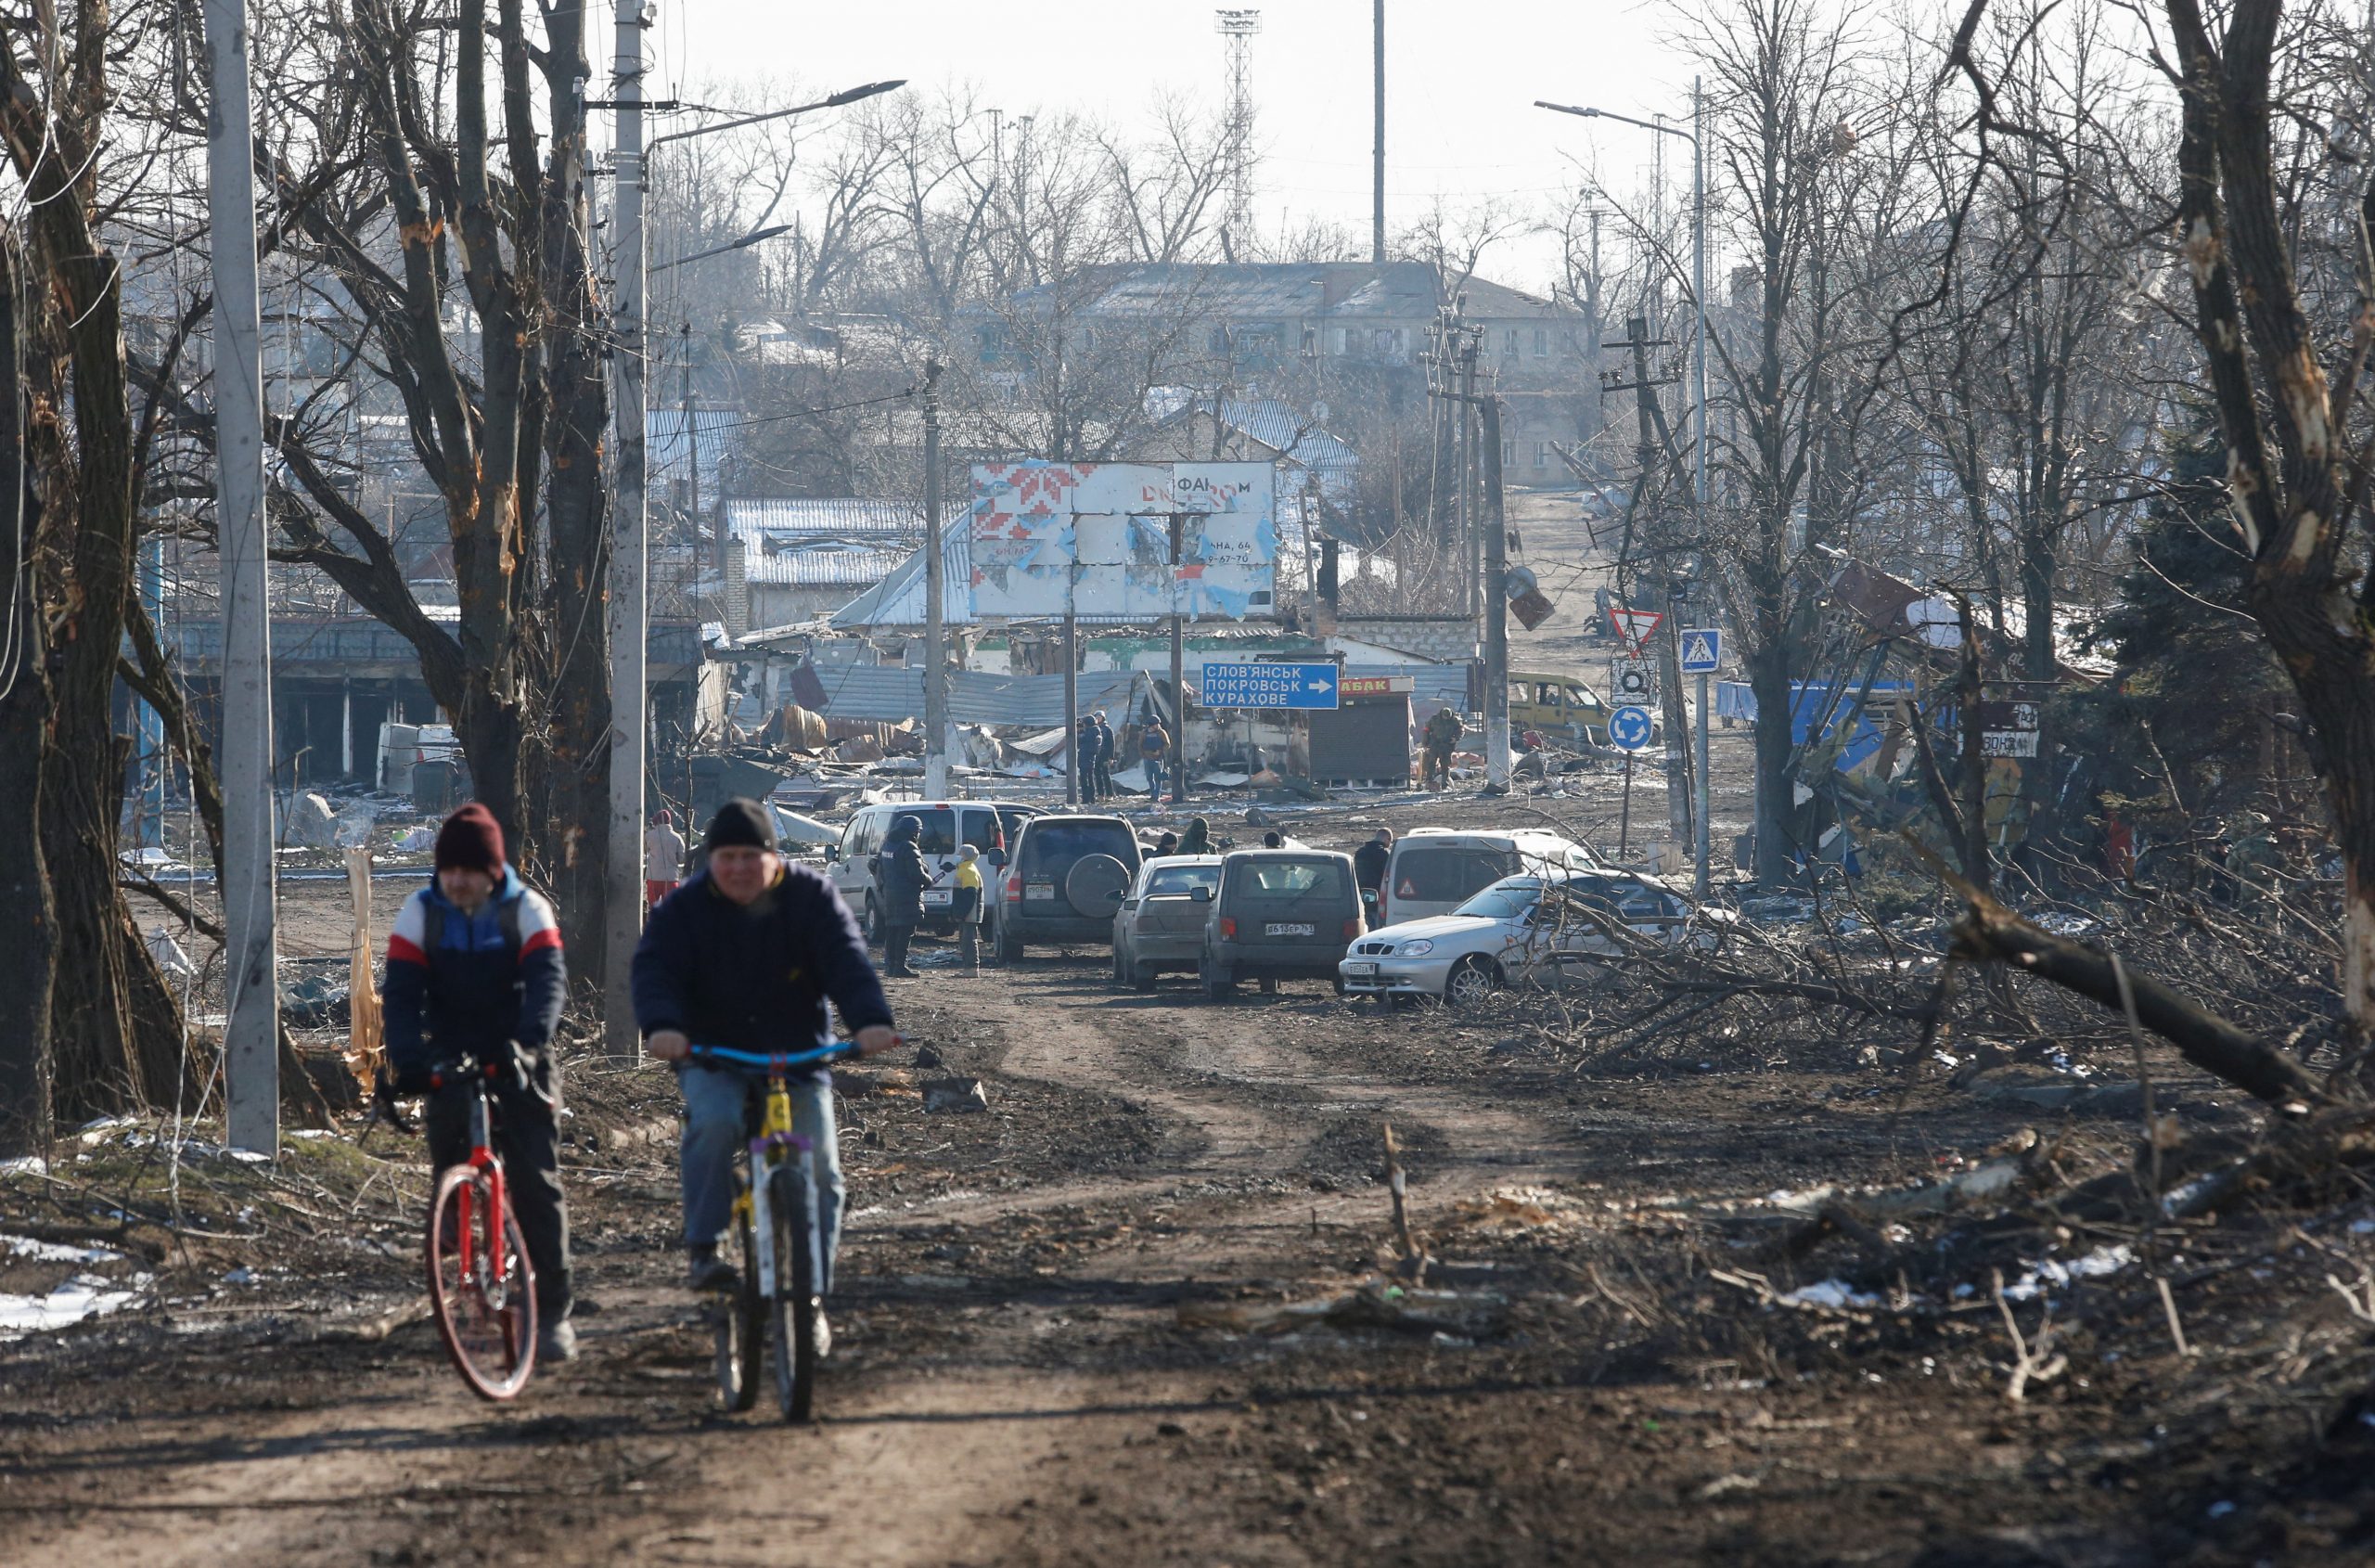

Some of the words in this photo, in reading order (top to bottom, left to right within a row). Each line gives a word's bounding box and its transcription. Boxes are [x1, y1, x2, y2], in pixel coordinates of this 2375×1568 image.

[1206, 665, 1302, 679] СЛОВ'ЯНСЬК
[1205, 679, 1301, 692] ПОКРОВСЬК
[1205, 693, 1288, 705] КУРАХОВЕ
